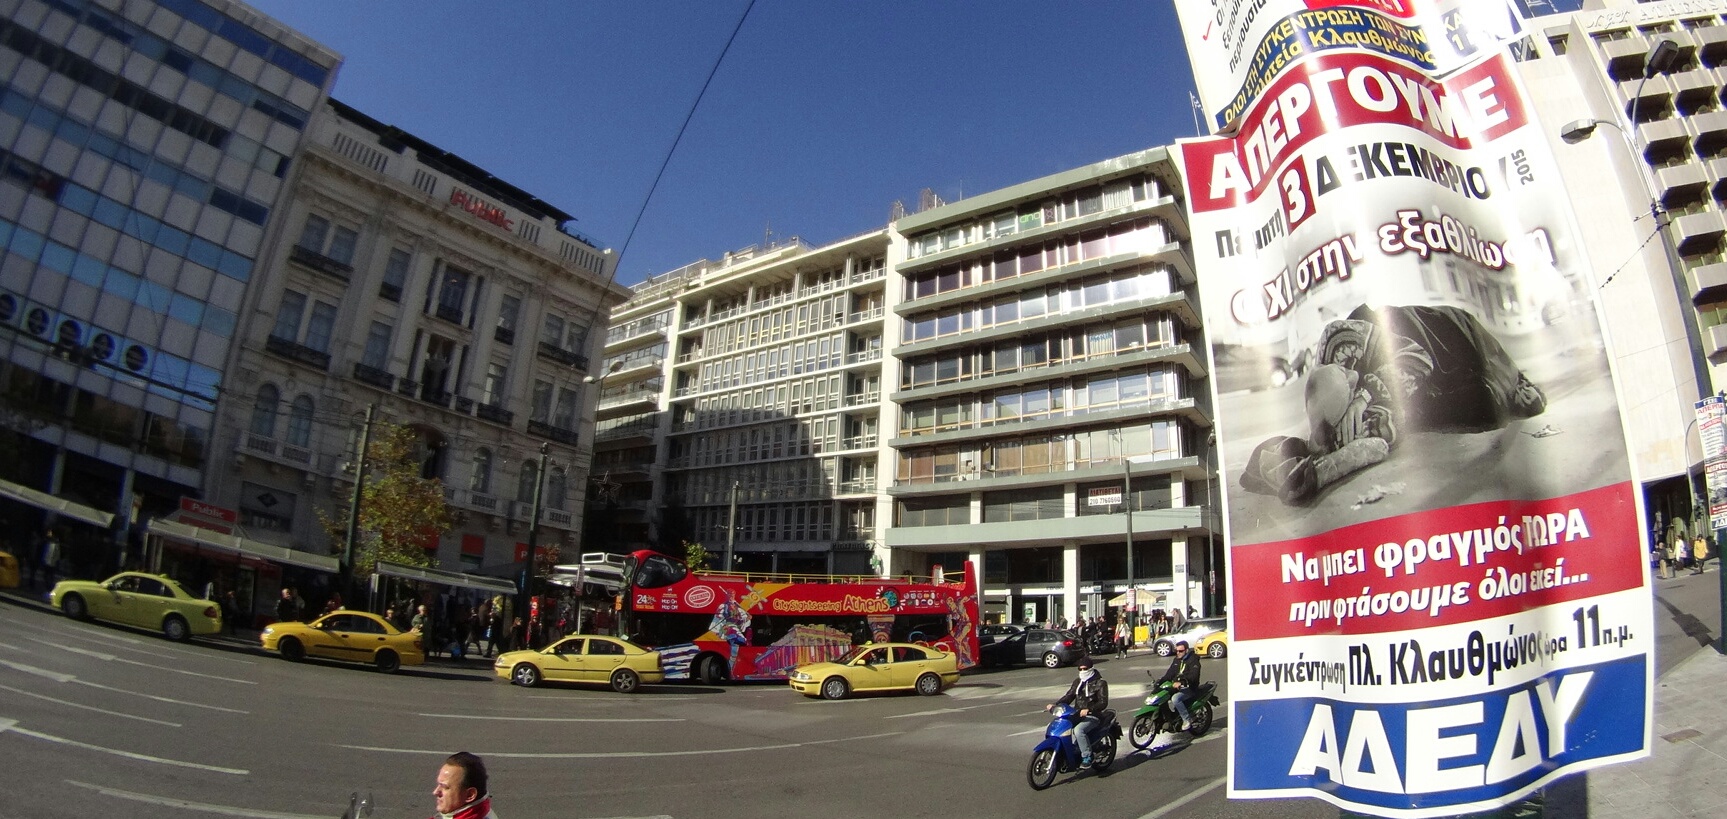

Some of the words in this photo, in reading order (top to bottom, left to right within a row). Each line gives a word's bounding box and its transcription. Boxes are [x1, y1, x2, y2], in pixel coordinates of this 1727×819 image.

[1225, 91, 1247, 124] ΟΛΟΙ
[1245, 63, 1259, 97] ΣΤΗ
[1256, 9, 1364, 70] ΣΥΓΚΕΝΤΡΩΣΗ
[1364, 12, 1397, 35] ΤΩΝ
[1308, 27, 1437, 65] Κλαυθμώνος
[1209, 65, 1510, 200] ΑΠΕΡΓΟΥΜΕ
[1282, 168, 1307, 224] 3
[1511, 149, 1535, 186] 2015
[1296, 231, 1365, 294] στην
[192, 502, 225, 519] Public
[1281, 551, 1320, 584] Να
[1322, 547, 1366, 587] μπει
[1374, 515, 1523, 578] φραγμός
[1522, 507, 1591, 549] ΤΩΡΑ
[843, 594, 891, 613] Athens
[1289, 599, 1332, 628] πριν
[1333, 581, 1471, 626] φτάσουμε
[1478, 566, 1528, 601] όλοι
[1530, 557, 1590, 592] εκεί...
[1249, 652, 1346, 694] Συγκέντρωση
[1348, 643, 1382, 686] Πλ.
[1389, 624, 1544, 686] Κλαυθμώνος
[1544, 632, 1568, 661] ώρα
[1572, 604, 1601, 649] 11
[1603, 625, 1634, 648] π.μ.
[1288, 671, 1595, 795] ΑΔΕΔΥ
